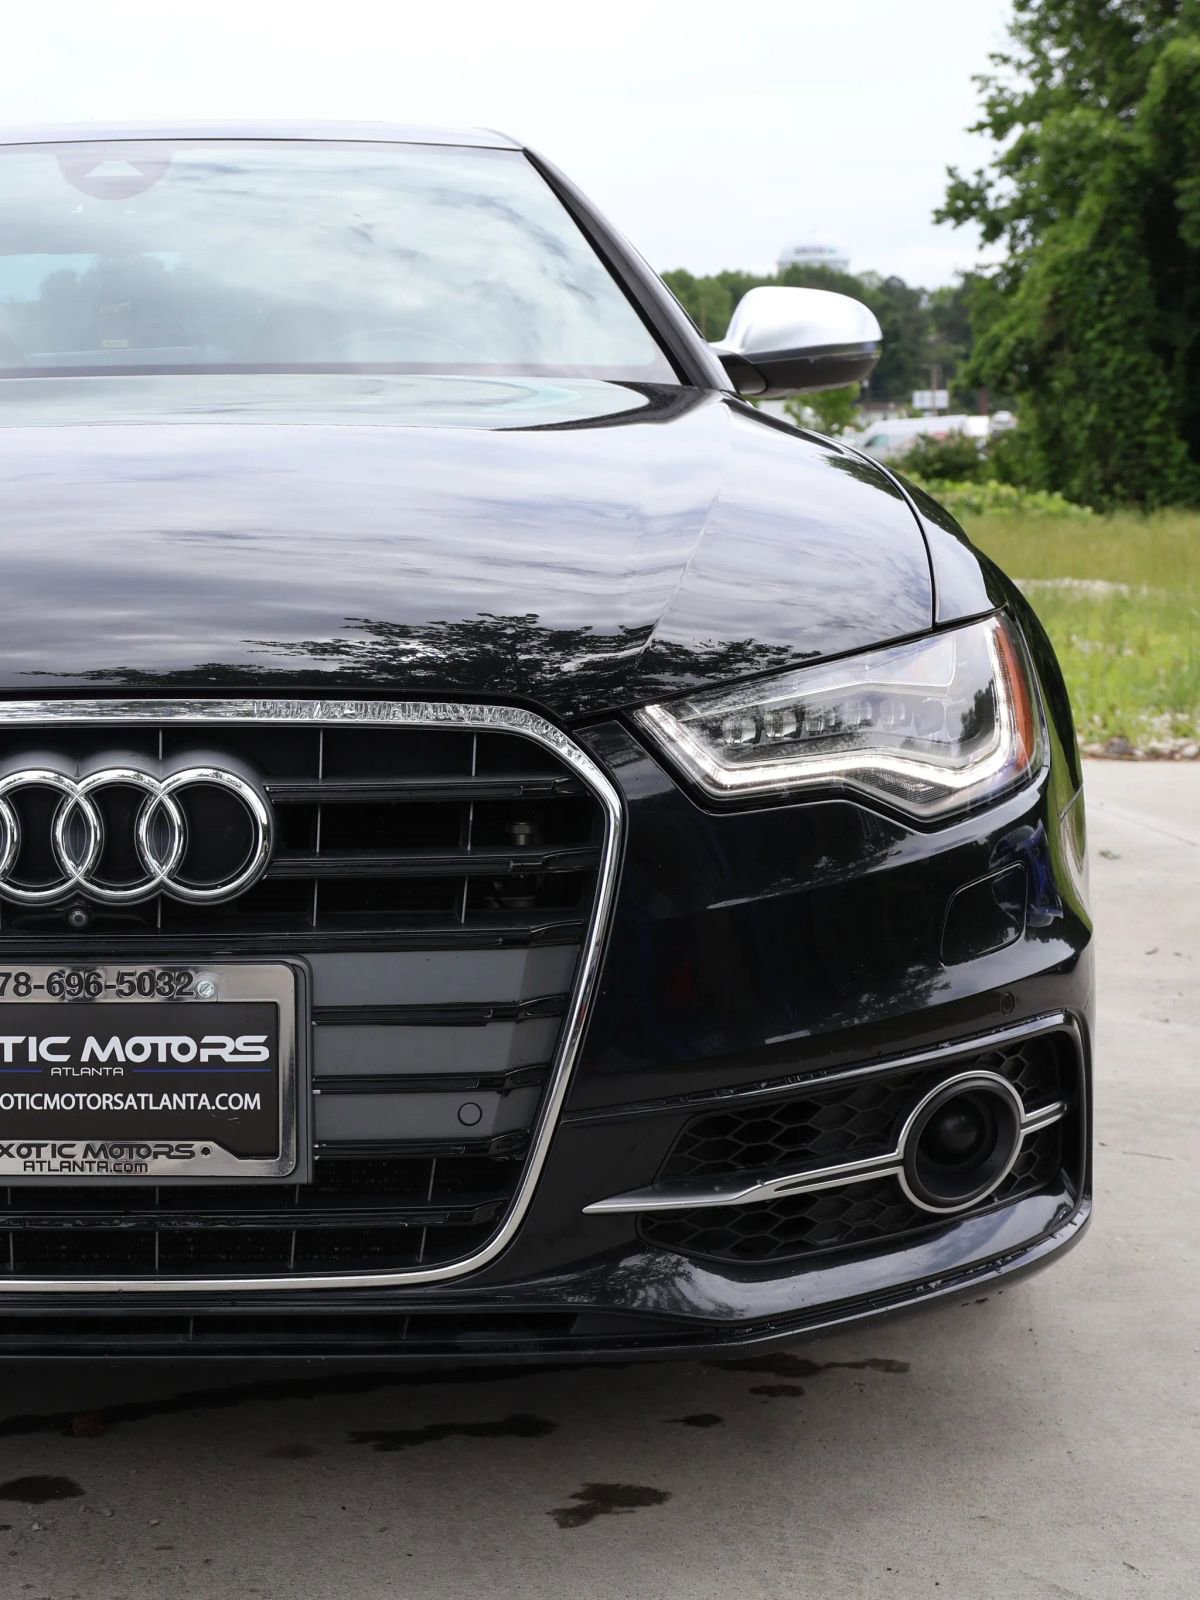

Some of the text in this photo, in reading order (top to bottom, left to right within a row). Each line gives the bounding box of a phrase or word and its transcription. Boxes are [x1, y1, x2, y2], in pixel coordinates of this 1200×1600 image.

[80, 1035, 270, 1063] MOTORS
[50, 1067, 124, 1076] ATLANTA
[82, 1143, 196, 1159] MOTORS
[23, 1160, 148, 1173] ATLANTA.com
